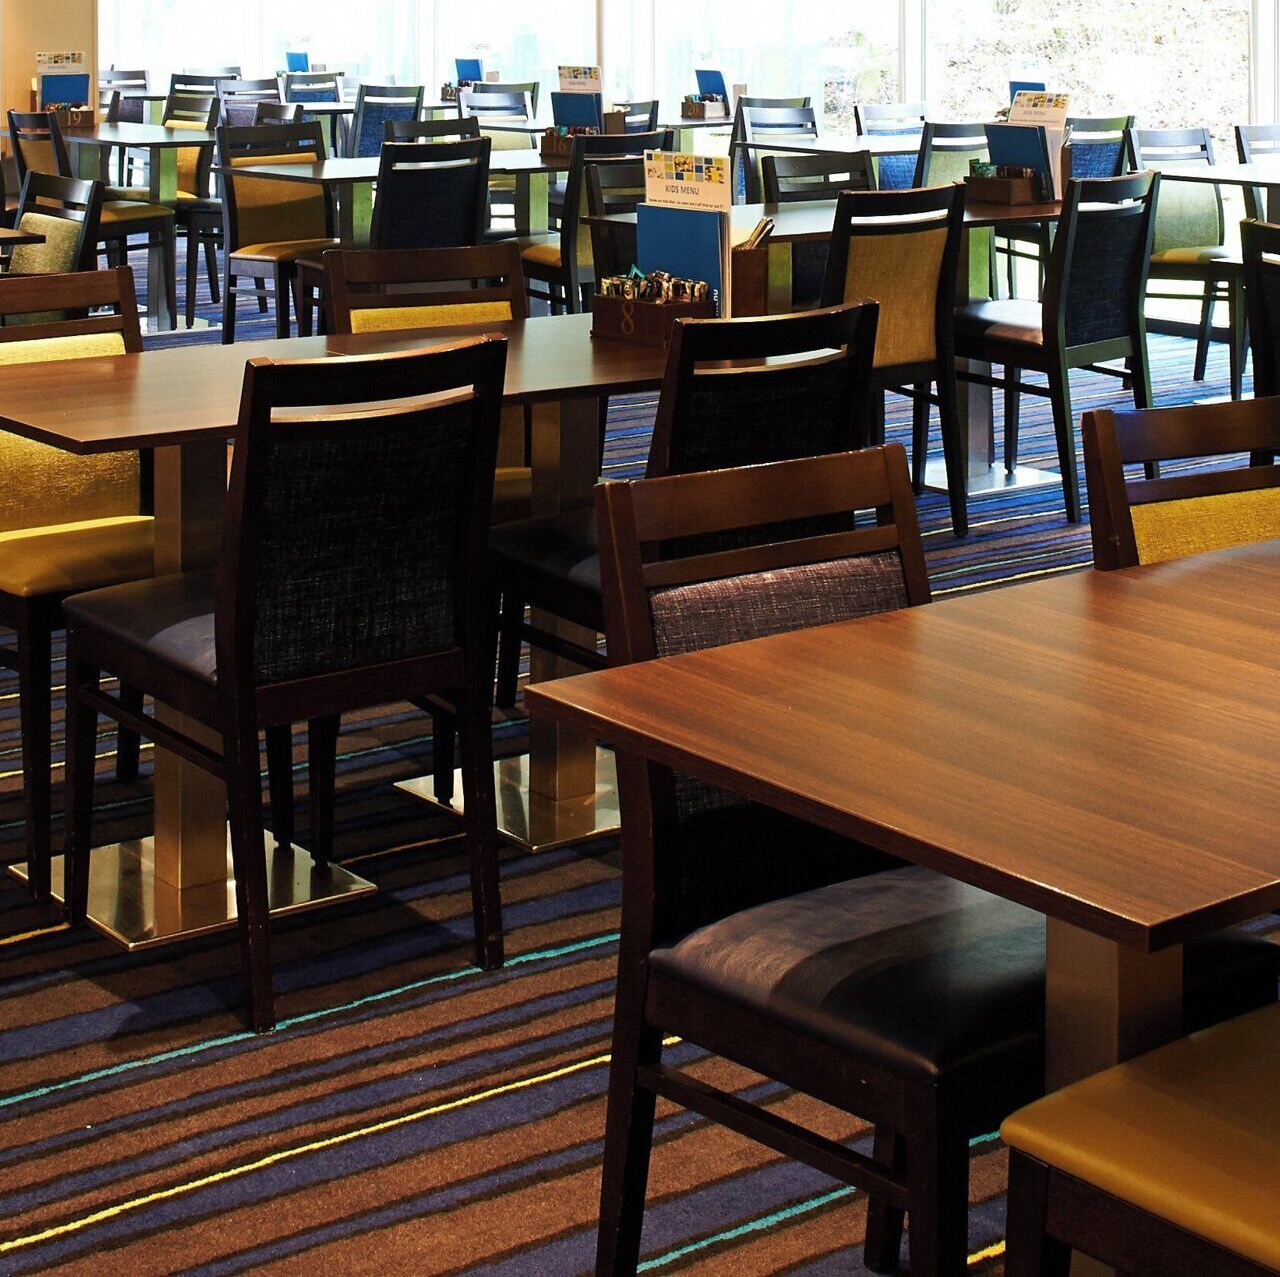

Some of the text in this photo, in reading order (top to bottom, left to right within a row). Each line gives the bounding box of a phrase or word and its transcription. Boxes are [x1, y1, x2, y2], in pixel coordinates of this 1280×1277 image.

[446, 87, 456, 99] 22
[687, 102, 699, 115] 20
[67, 112, 82, 126] 19
[553, 137, 568, 154] 16
[665, 185, 700, 195] KIDS MENU
[621, 302, 635, 335] 8
